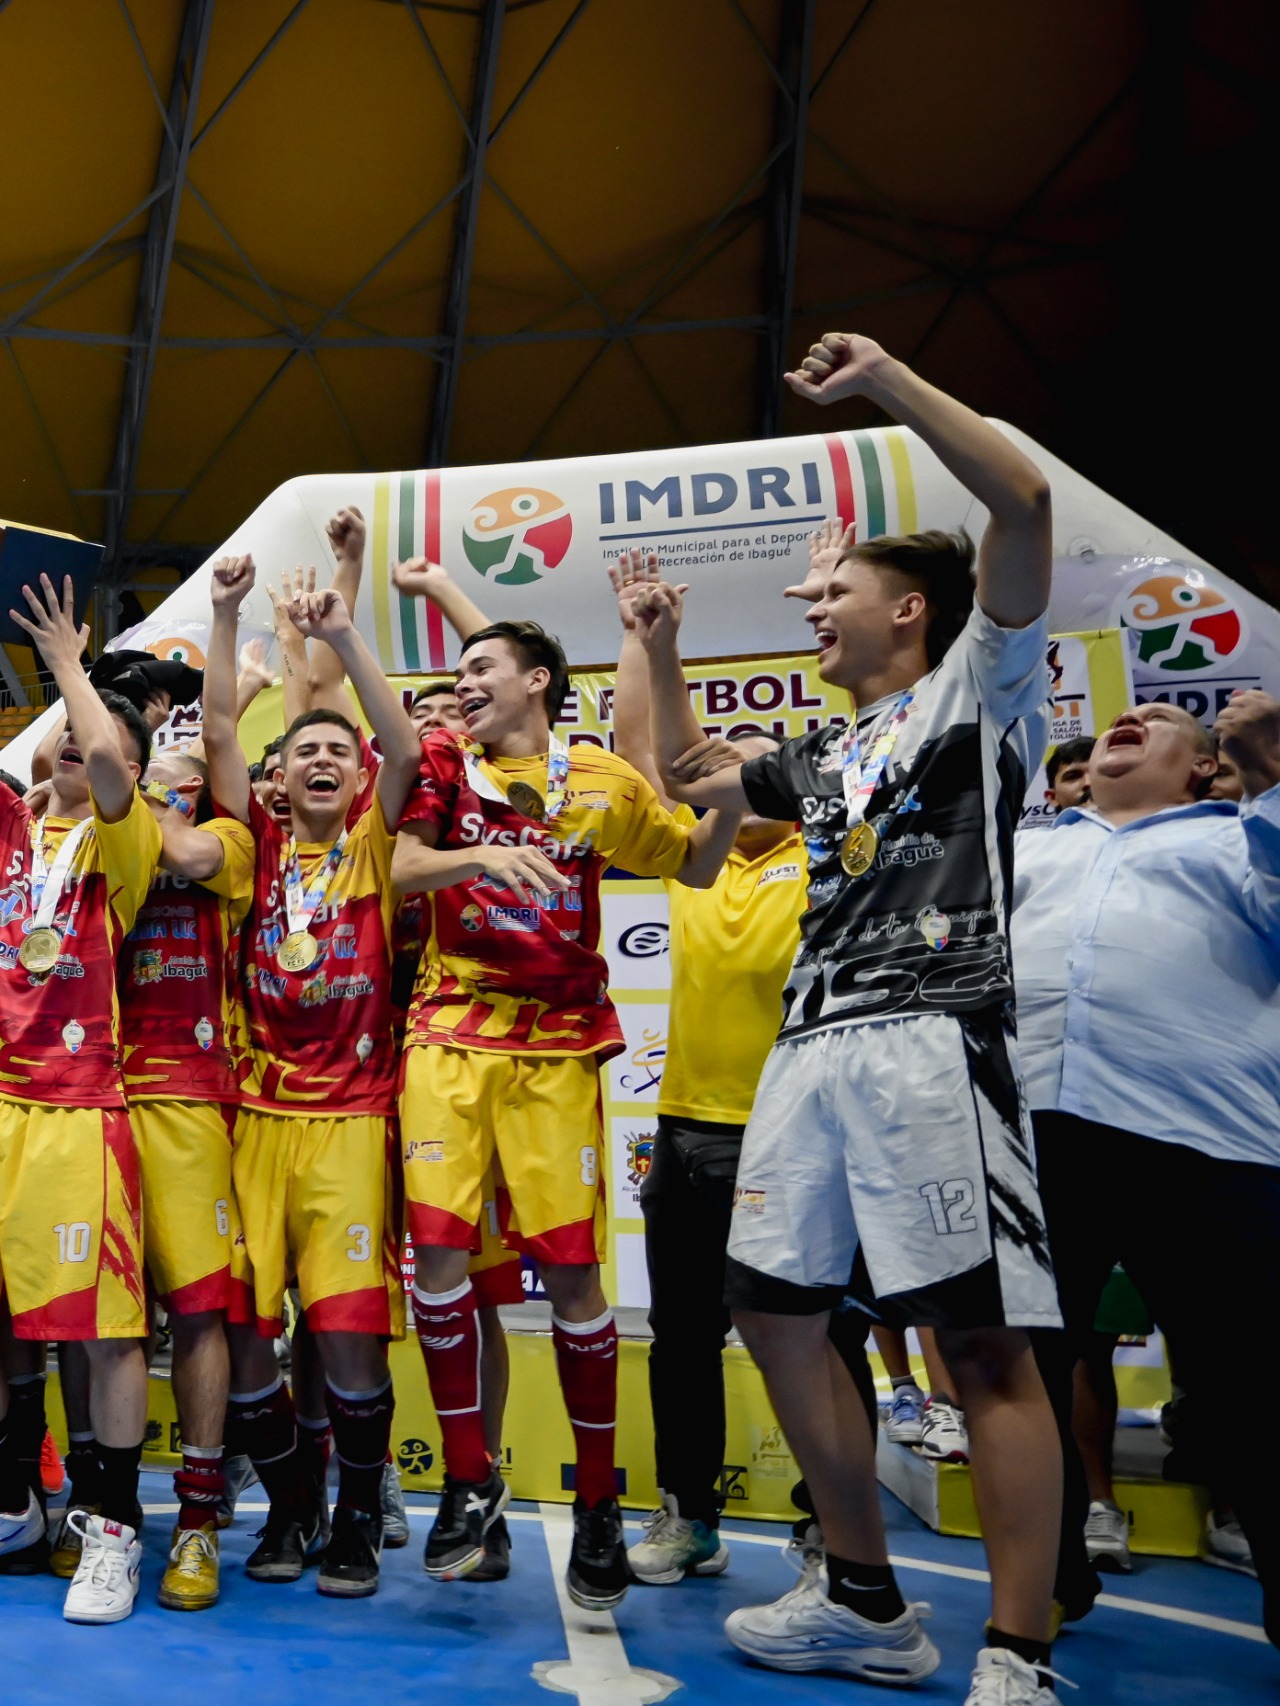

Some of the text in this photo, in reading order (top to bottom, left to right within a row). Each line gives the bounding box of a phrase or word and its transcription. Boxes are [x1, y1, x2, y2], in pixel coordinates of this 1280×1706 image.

[599, 462, 822, 524] IMDRI
[657, 539, 717, 555] Municipal
[722, 537, 750, 552] para
[754, 534, 766, 546] el
[770, 530, 822, 548] Depore
[658, 550, 725, 567] Recreación
[729, 548, 744, 561] de
[875, 840, 944, 870] Ibagué
[488, 906, 539, 922] IMDRI
[50, 965, 85, 980] bagué
[580, 1145, 596, 1186] 8
[215, 1199, 229, 1236] 6
[919, 1178, 977, 1235] 12
[53, 1222, 91, 1264] 10
[346, 1224, 370, 1261] 3
